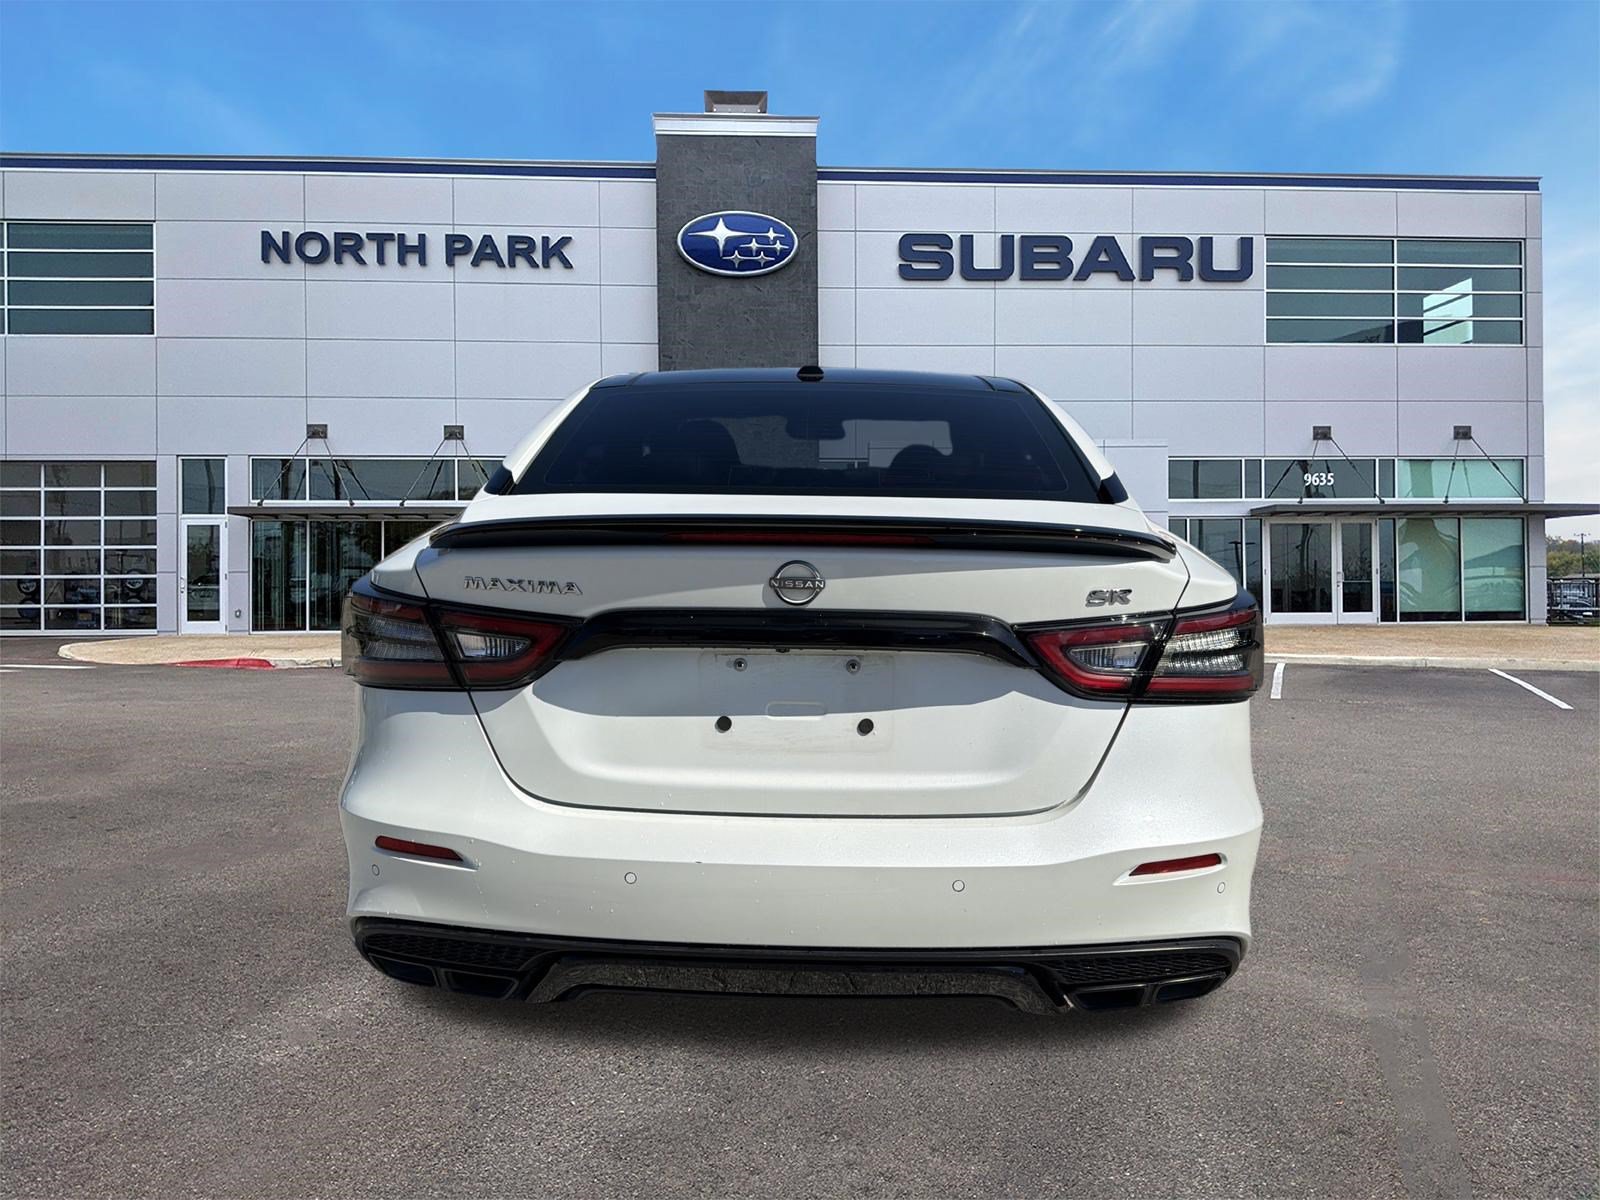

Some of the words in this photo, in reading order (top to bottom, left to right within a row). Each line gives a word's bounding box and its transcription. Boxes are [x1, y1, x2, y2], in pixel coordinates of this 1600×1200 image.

[260, 230, 427, 267] NORTH
[445, 234, 575, 269] PARK
[898, 232, 1254, 282] SUBARU
[1303, 472, 1335, 486] 9635
[463, 575, 584, 595] MAXIMA
[769, 579, 825, 588] NISSAN
[1085, 588, 1133, 608] SR
